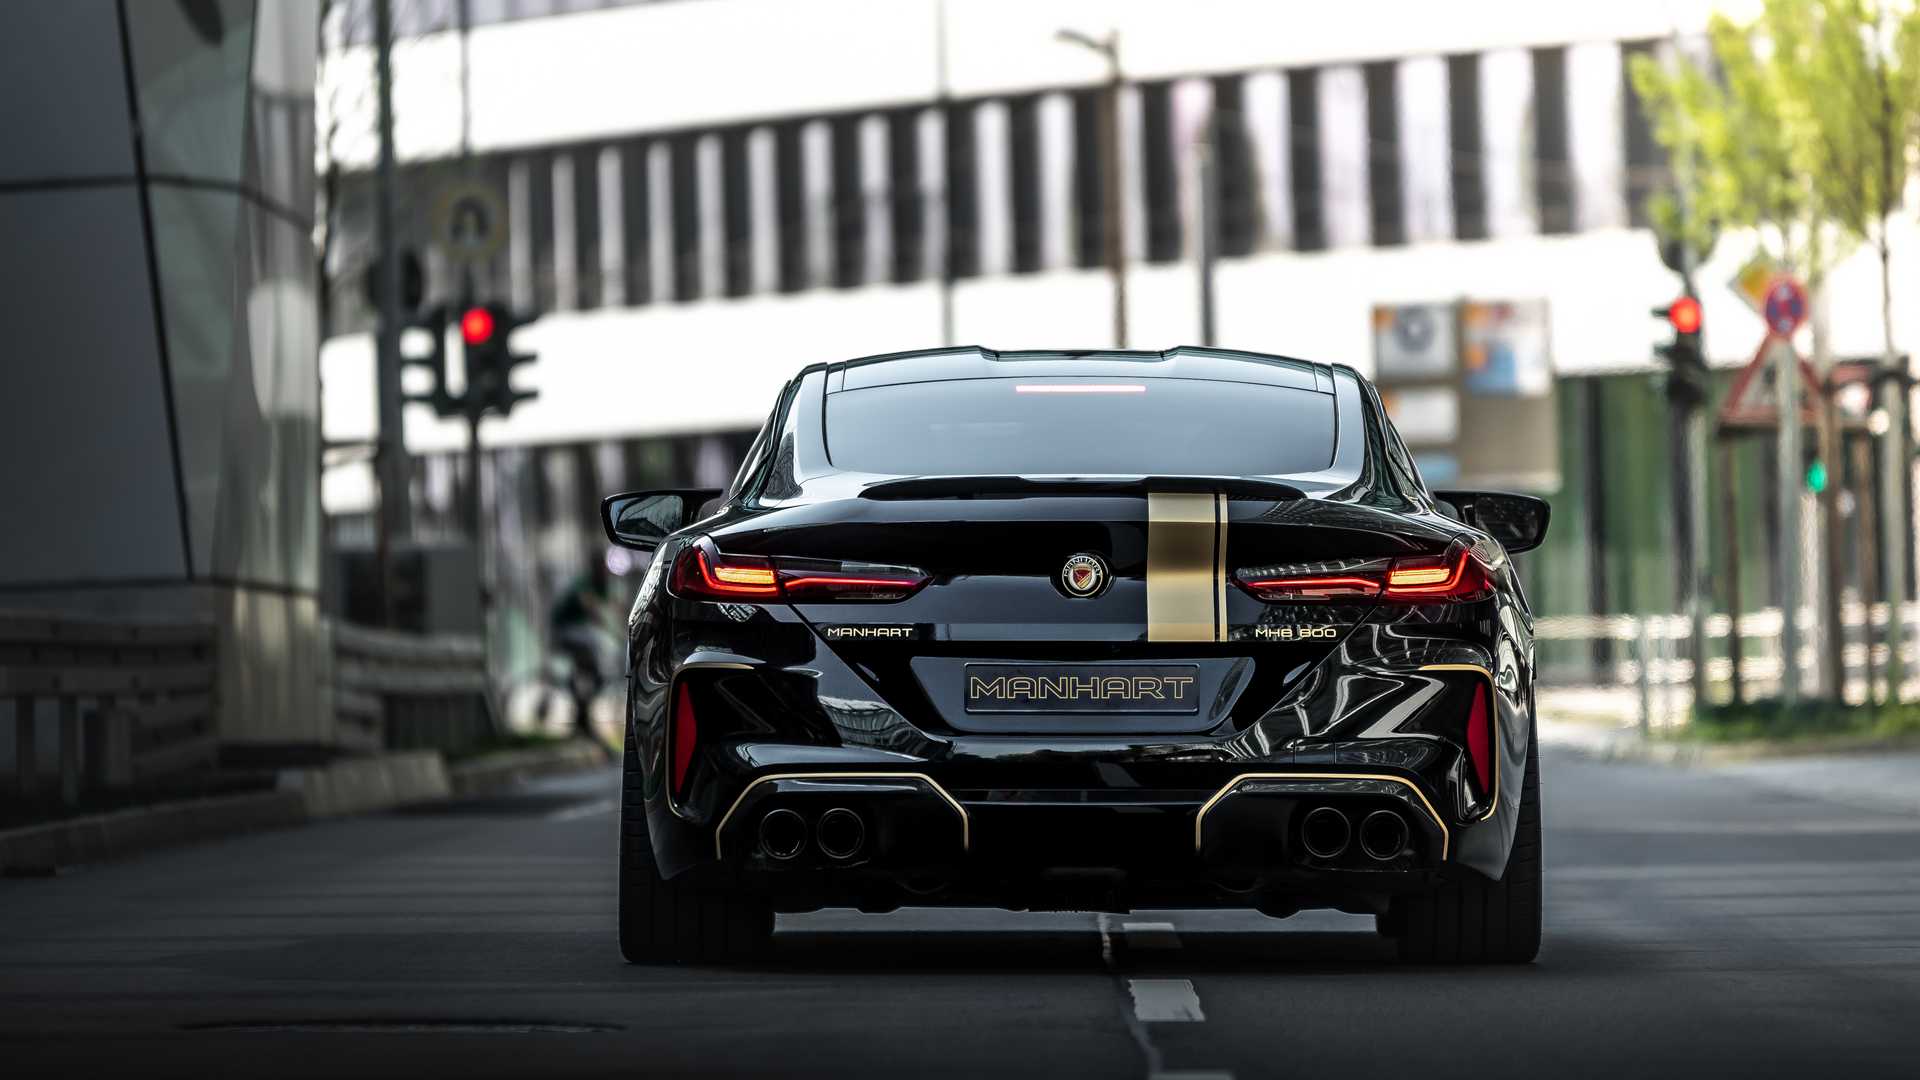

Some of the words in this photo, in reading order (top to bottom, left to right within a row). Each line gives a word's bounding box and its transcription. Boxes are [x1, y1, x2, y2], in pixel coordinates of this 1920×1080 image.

[827, 627, 913, 637] MANHART
[1299, 628, 1337, 638] 800
[970, 676, 1193, 699] MANHART
